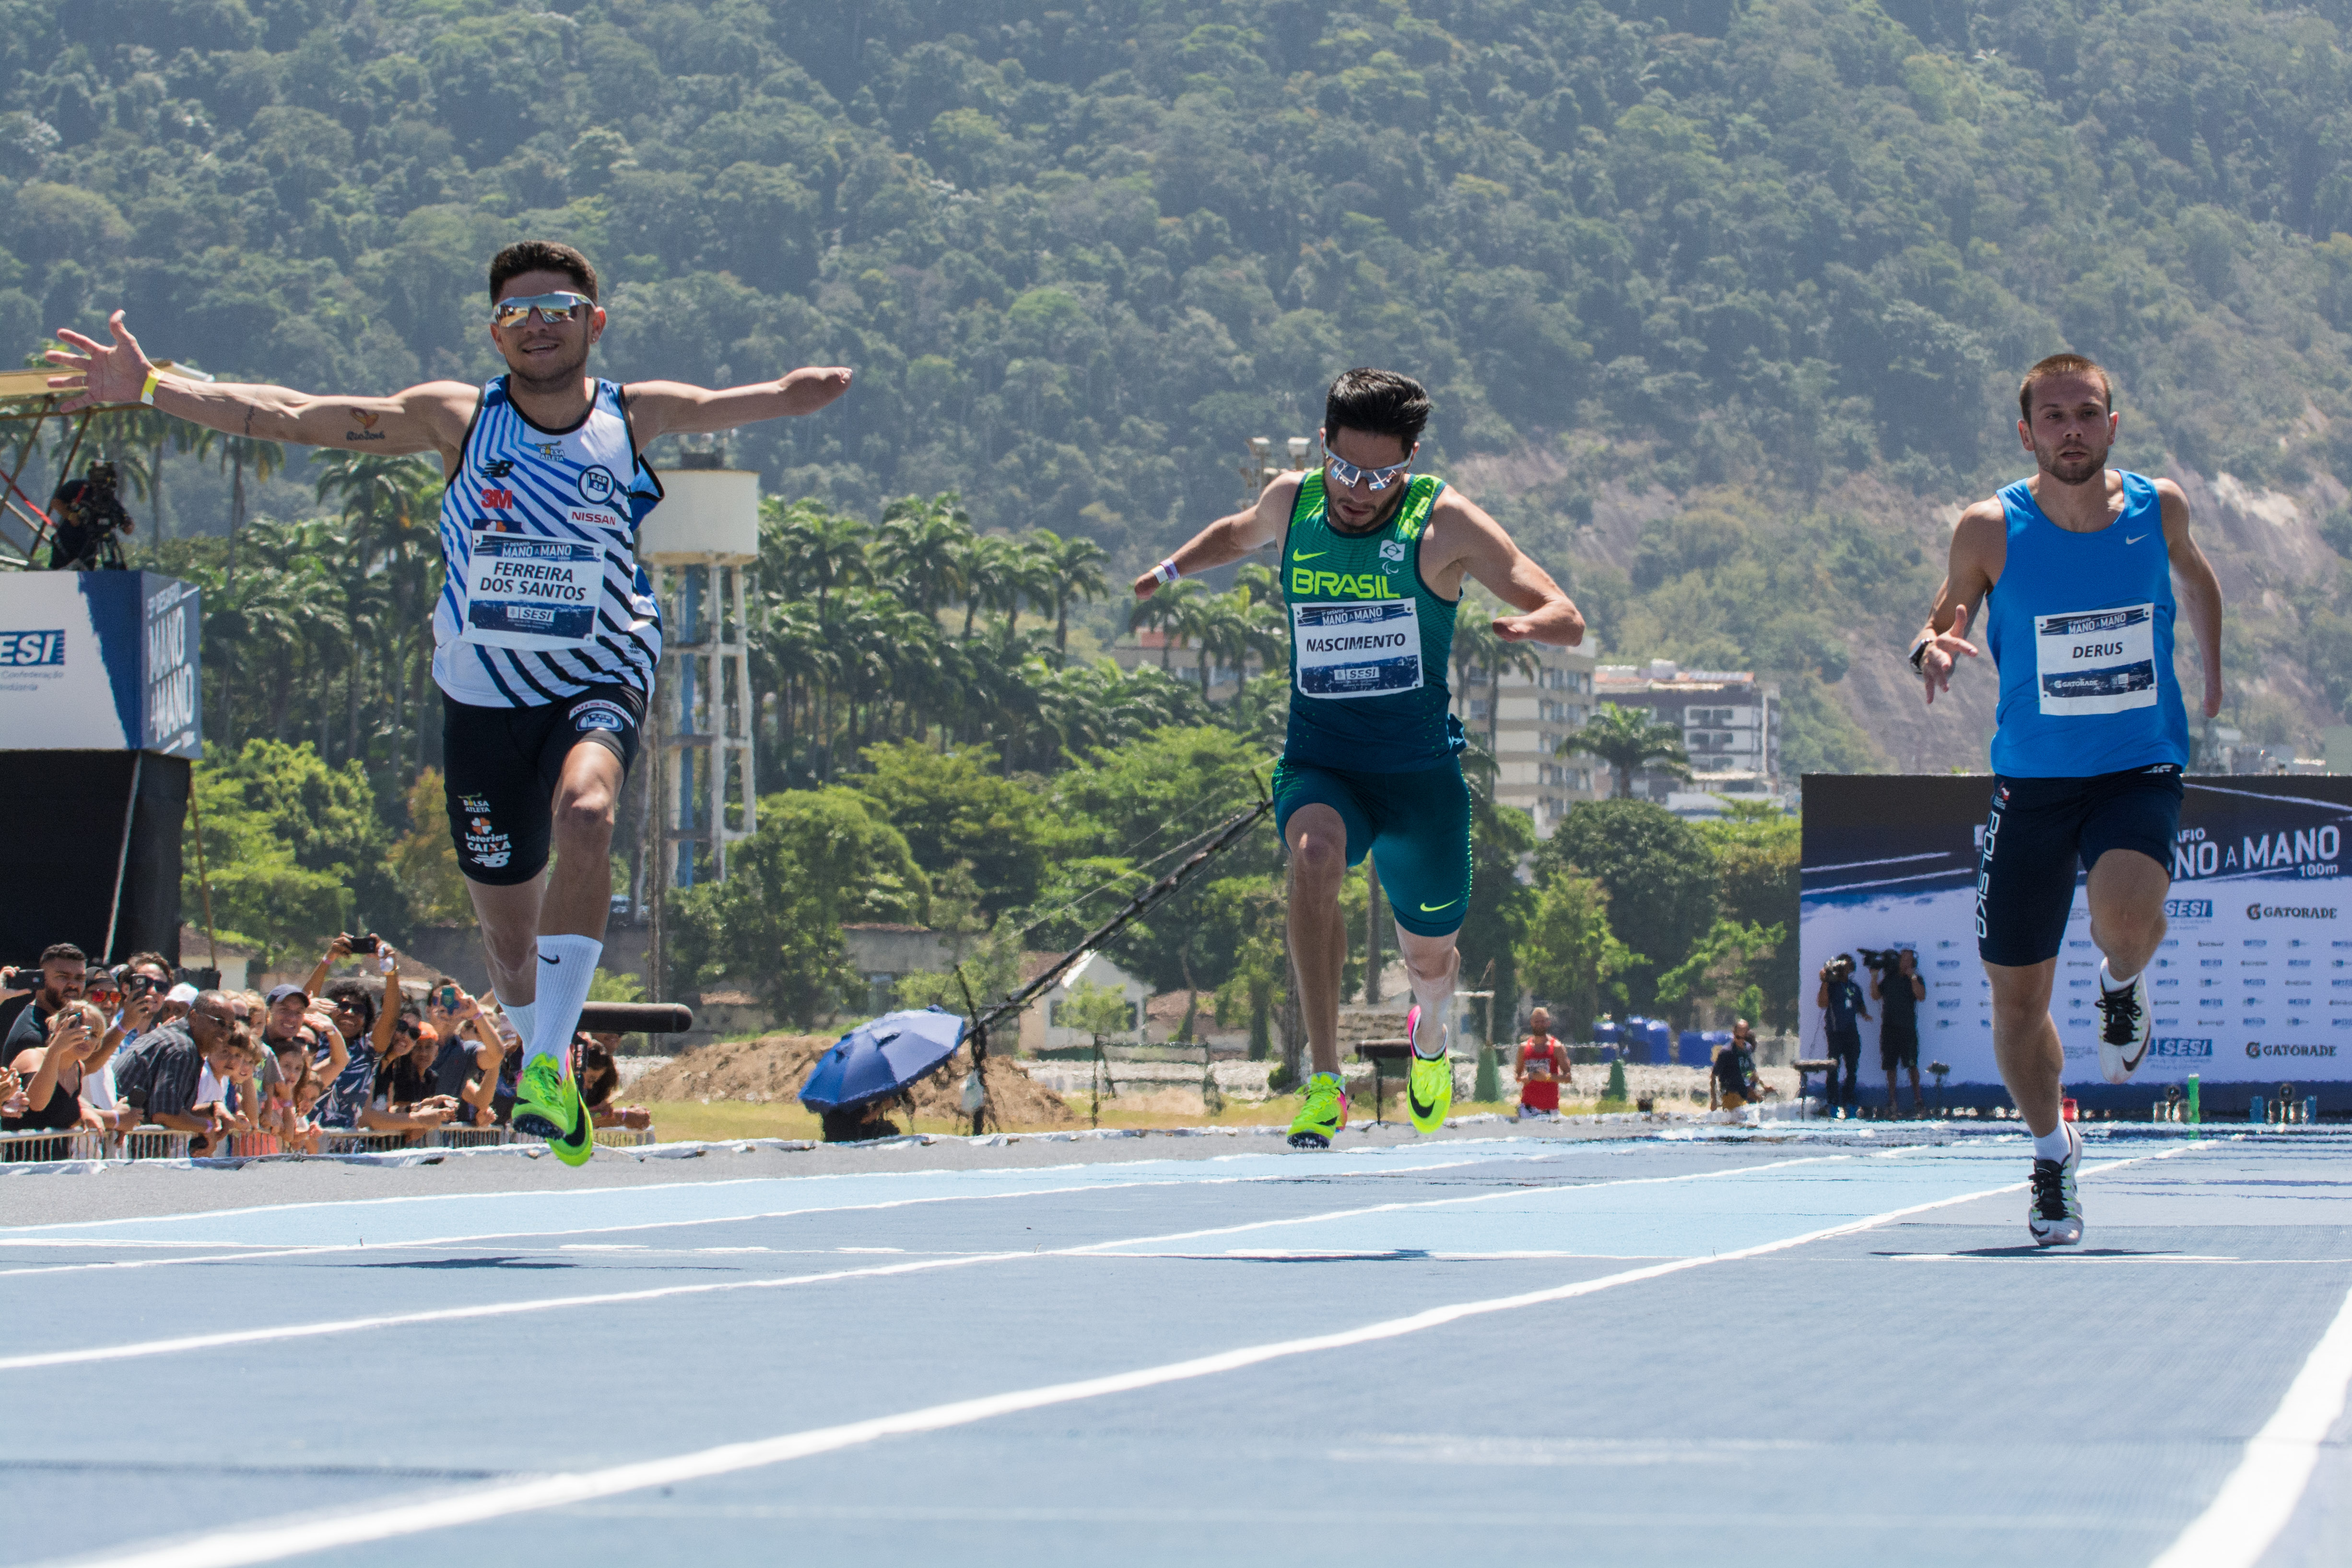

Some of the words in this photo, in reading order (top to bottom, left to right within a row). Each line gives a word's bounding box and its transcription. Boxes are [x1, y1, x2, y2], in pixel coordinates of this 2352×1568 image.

[481, 489, 513, 509] 3M
[572, 511, 616, 526] NISSAN
[502, 546, 533, 557] MANO
[540, 545, 572, 556] MANO
[494, 562, 574, 583] FERREIRA
[480, 578, 514, 593] DOS
[518, 581, 587, 601] SANTOS
[1292, 567, 1401, 599] BRASIL
[523, 609, 552, 620] SESI
[1322, 613, 1348, 626] MANO
[1354, 607, 1383, 620] MANO
[2068, 621, 2095, 635] MANO
[2100, 613, 2127, 628] MANO
[0, 634, 56, 664] ESI
[1306, 633, 1406, 652] NASCIMENTO
[2072, 642, 2123, 659] DERUS
[1350, 669, 1376, 678] SESI
[465, 832, 509, 843] Loterias
[467, 840, 512, 852] CAIXA
[2225, 845, 2237, 868] A
[2243, 825, 2340, 870] MANO
[1976, 811, 2000, 939] POLSKA
[2299, 863, 2339, 877] 100m
[2165, 901, 2207, 917] SESI
[2263, 907, 2338, 920] GATORADE
[2162, 1040, 2207, 1056] SESI
[2263, 1044, 2338, 1058] GATORADE
